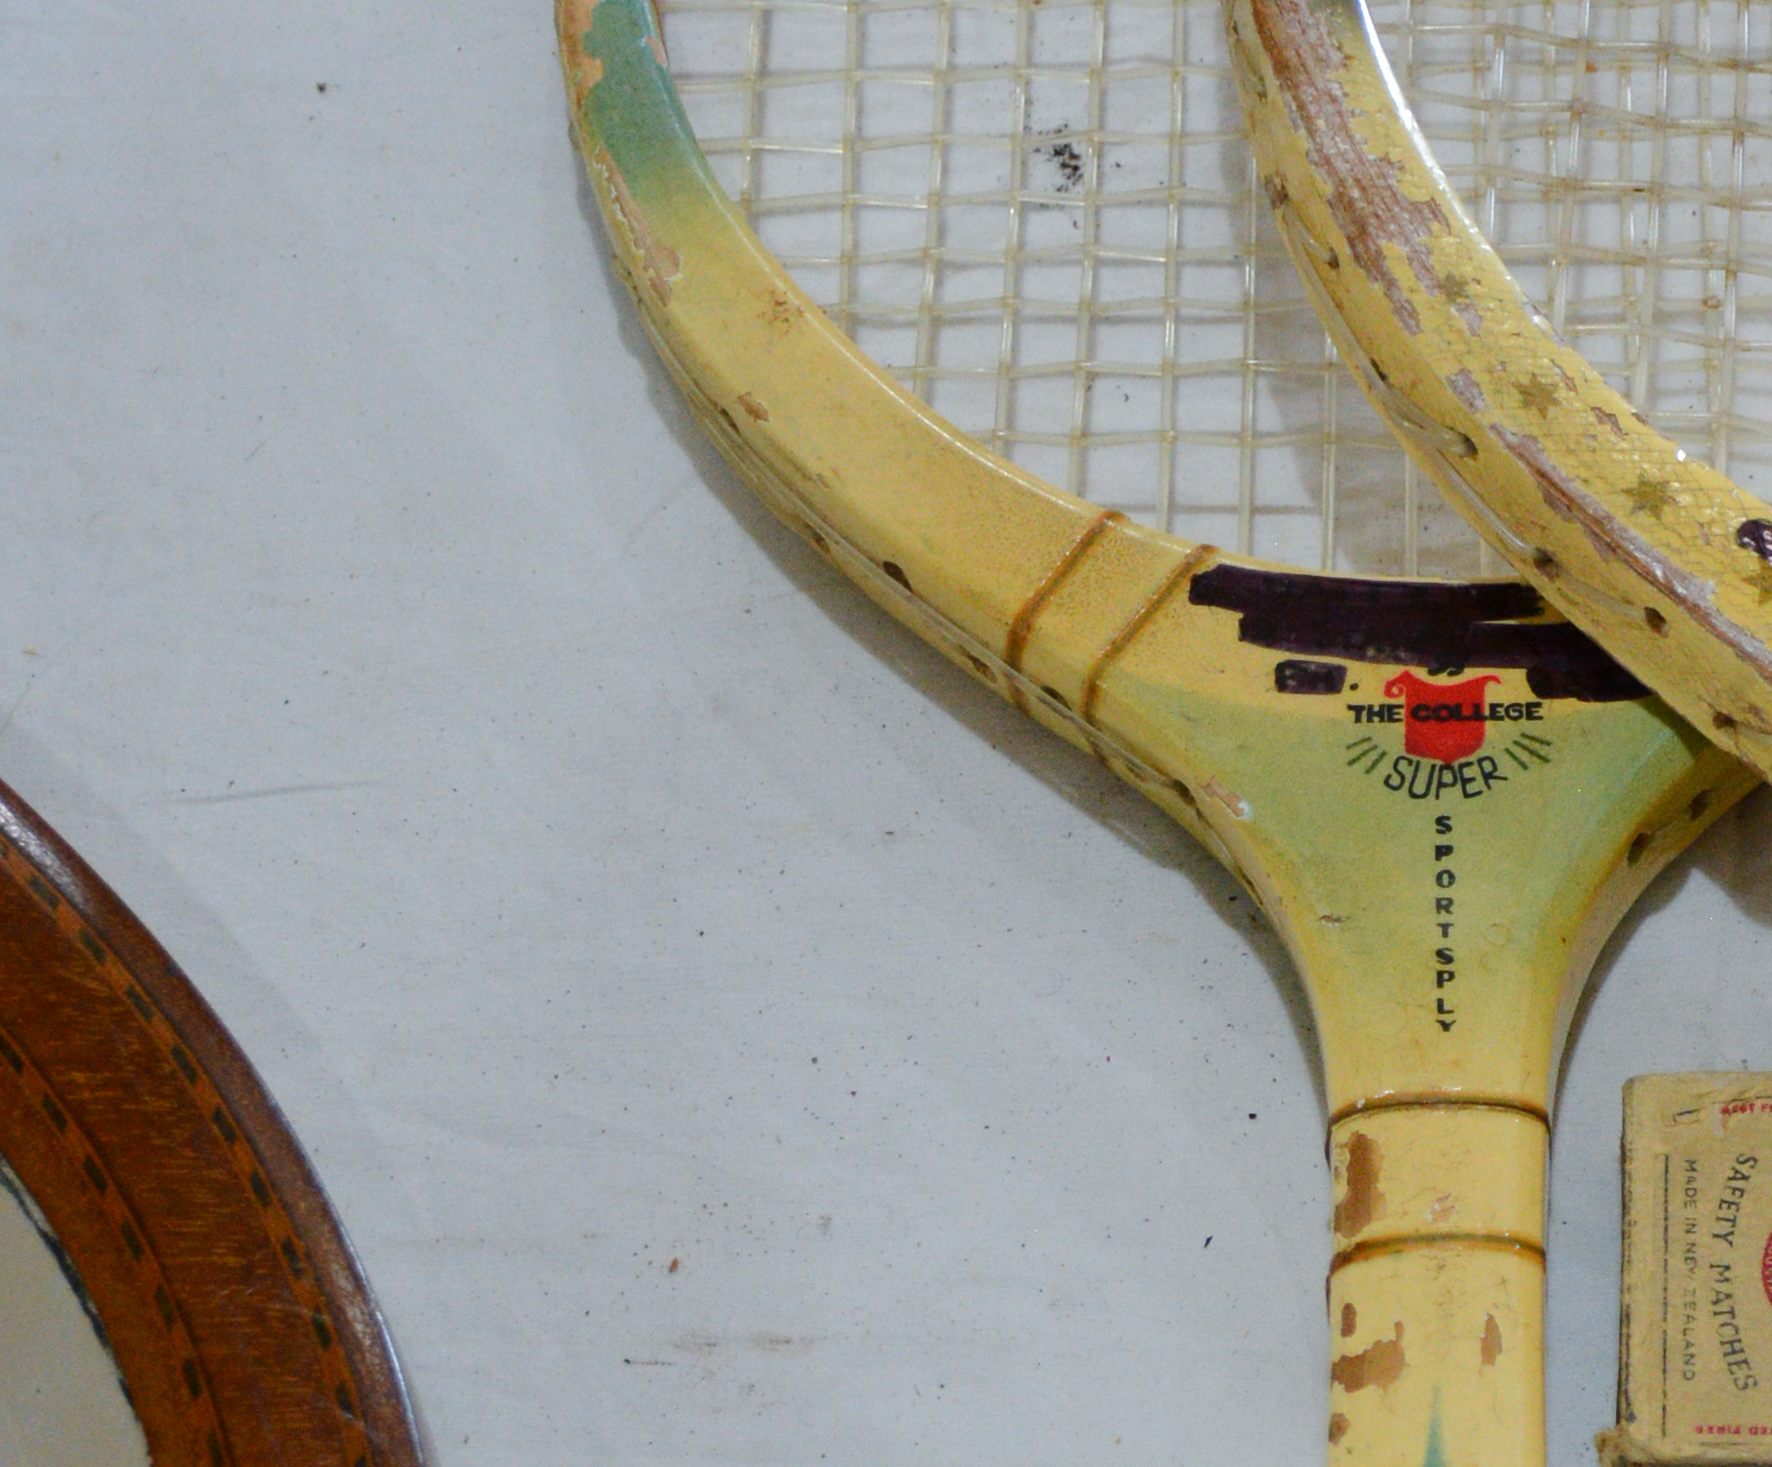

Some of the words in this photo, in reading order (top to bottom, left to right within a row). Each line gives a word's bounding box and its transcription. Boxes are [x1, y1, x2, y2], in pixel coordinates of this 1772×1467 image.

[1347, 704, 1404, 724] THE
[1410, 701, 1543, 723] COLLEGE
[1384, 755, 1508, 800] SUPER
[1434, 814, 1456, 1032] SPORTSPLY
[1683, 1159, 1698, 1208] MADE
[1712, 1152, 1758, 1248] SAFETY
[1684, 1216, 1697, 1234] IN
[1682, 1288, 1698, 1382] ZEALAND
[1710, 1262, 1758, 1392] MATCHES
